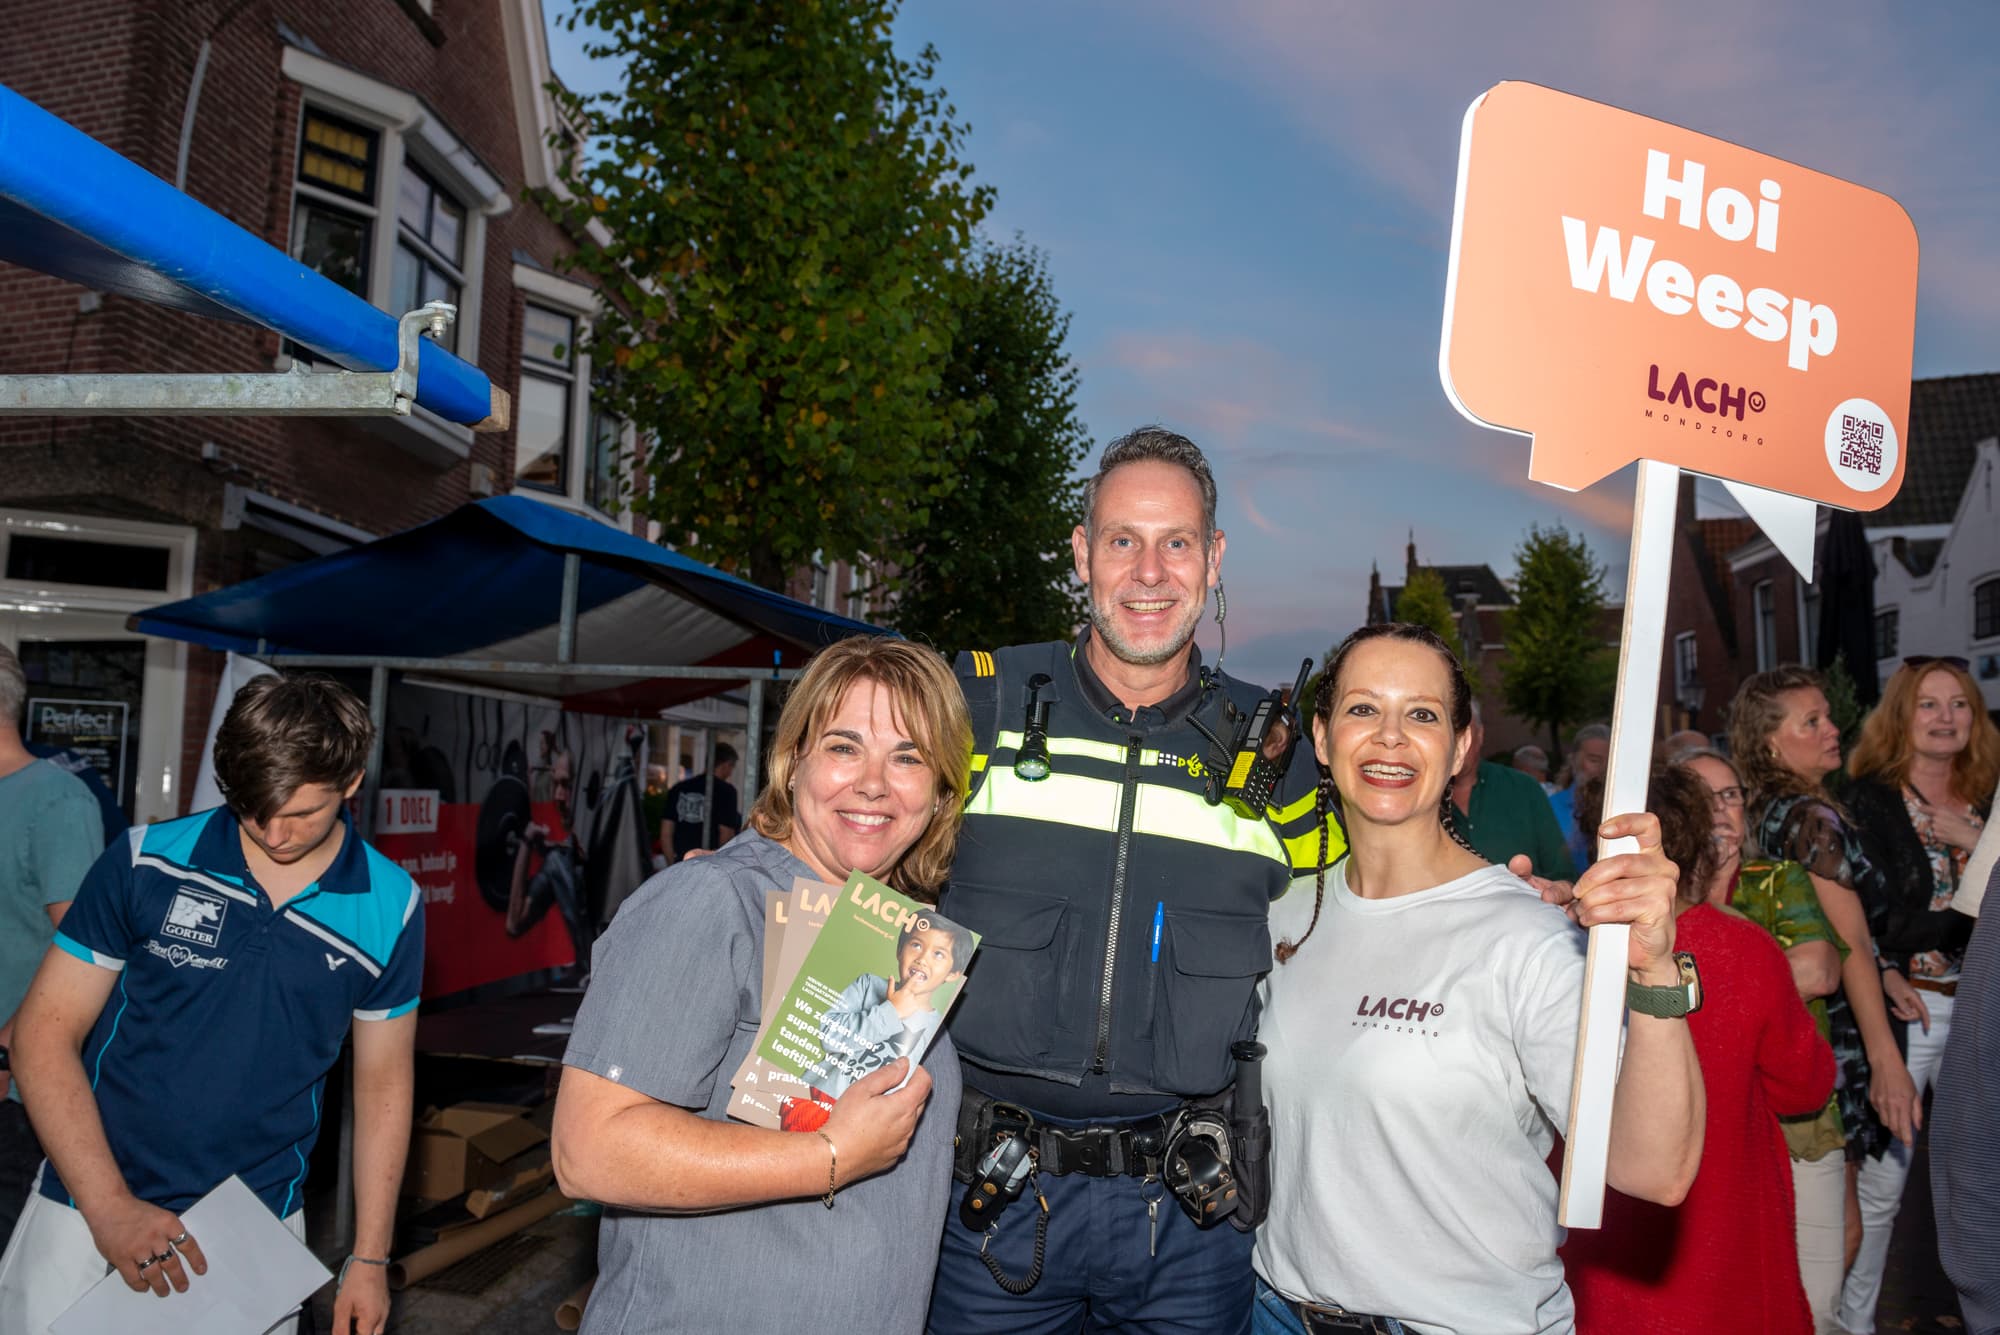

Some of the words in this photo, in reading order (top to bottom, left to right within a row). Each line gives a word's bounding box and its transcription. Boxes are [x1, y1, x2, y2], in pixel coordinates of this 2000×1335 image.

[1643, 148, 1782, 253] Hoi
[1561, 215, 1838, 371] Weesp
[1645, 409, 1763, 445] MONDZORG
[165, 924, 214, 944] GORTER
[779, 1026, 822, 1059] tanden,
[786, 1013, 855, 1057] supersterke
[794, 997, 813, 1015] We
[813, 1010, 851, 1038] zorgen
[853, 1032, 880, 1052] voor
[771, 1038, 828, 1079] leeftijden.
